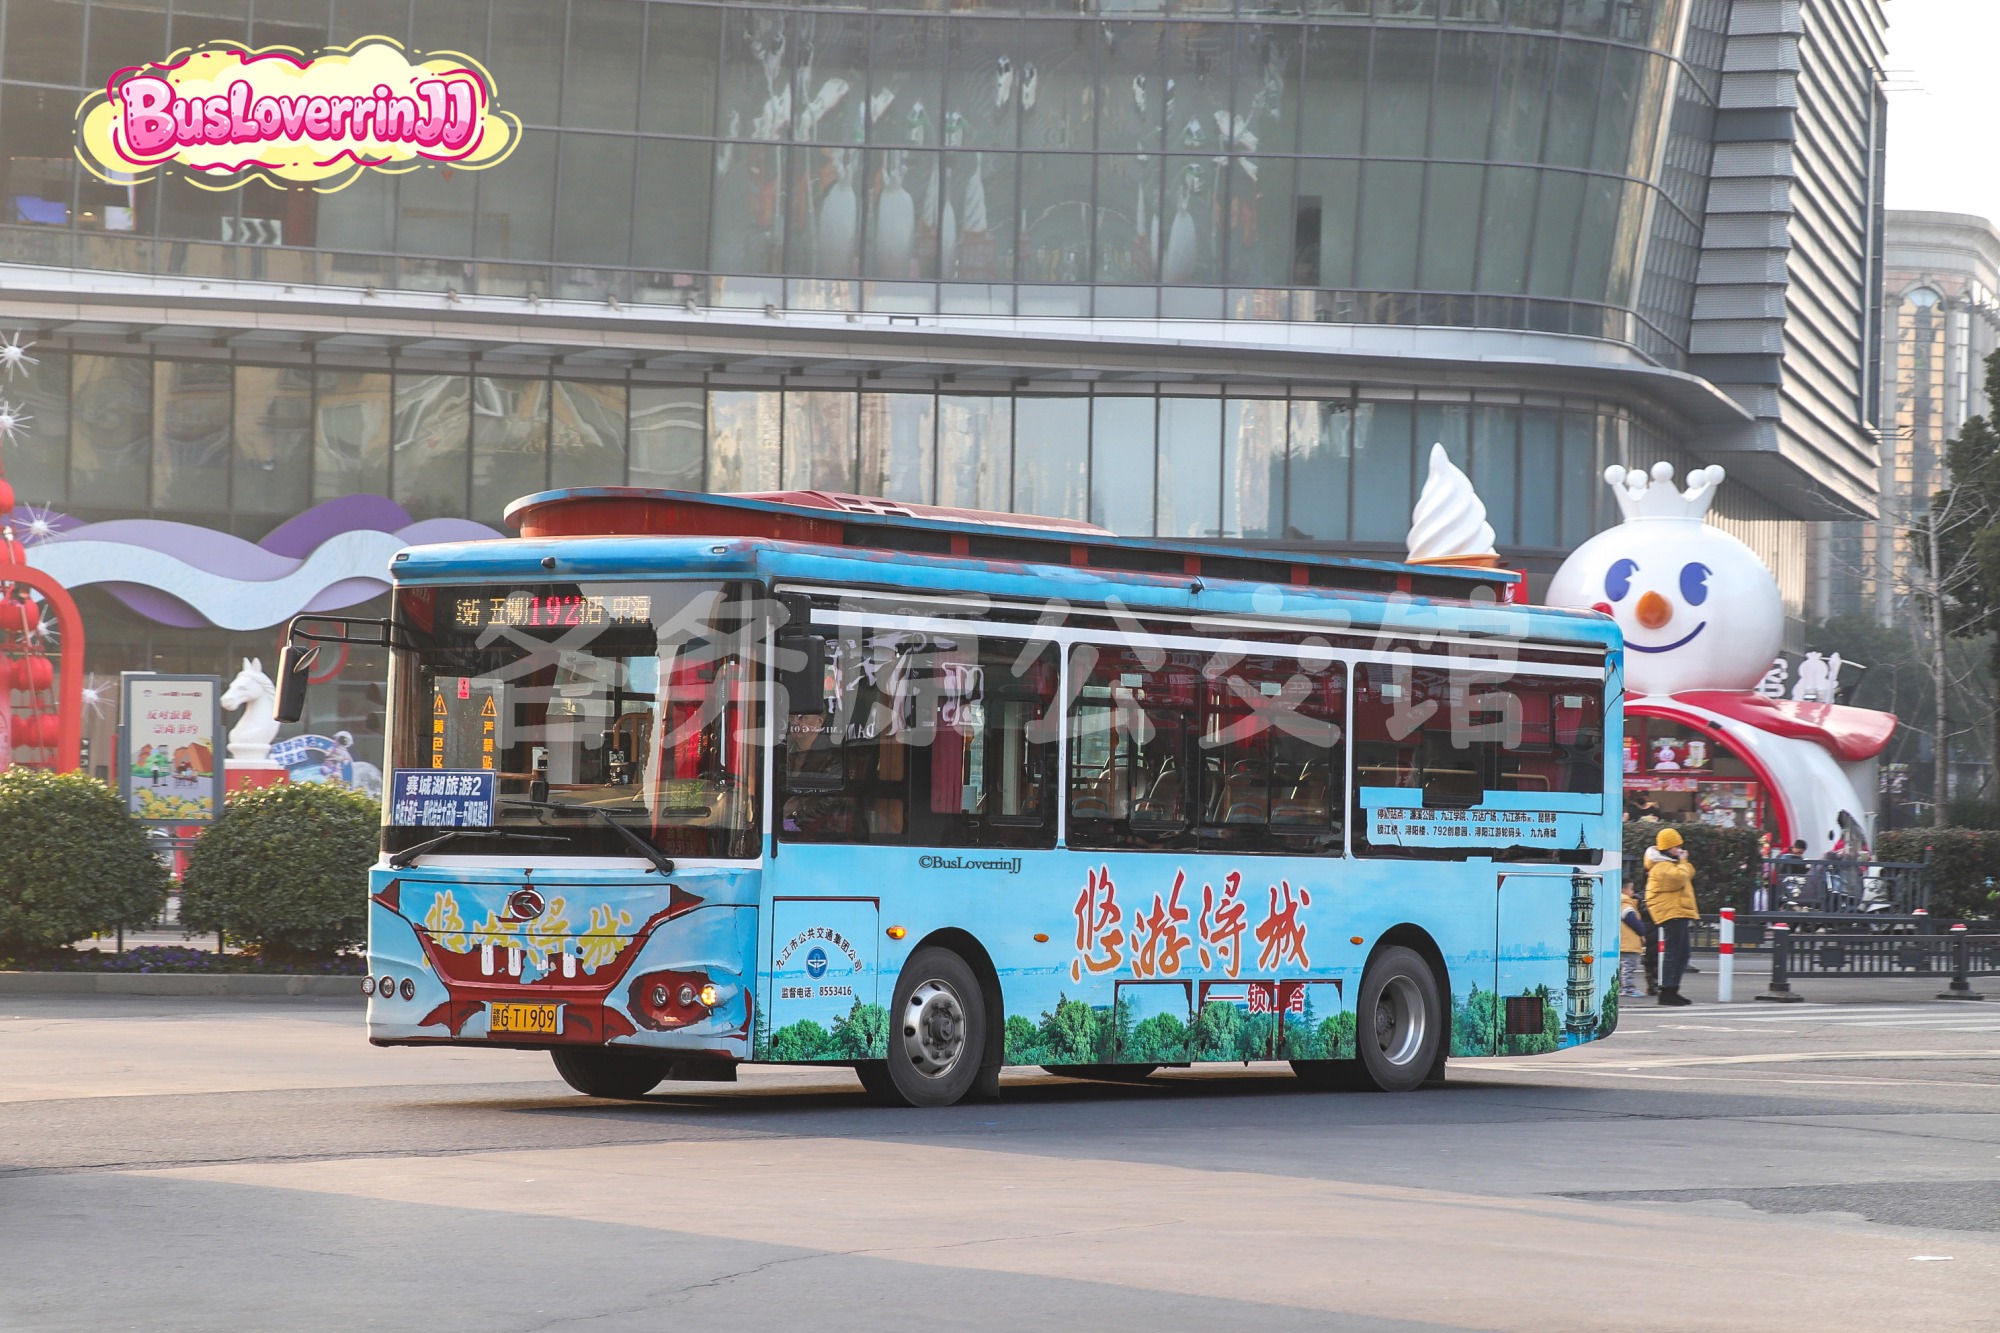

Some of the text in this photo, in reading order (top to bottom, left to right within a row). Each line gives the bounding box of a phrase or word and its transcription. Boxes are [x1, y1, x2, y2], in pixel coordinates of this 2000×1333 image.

[530, 596, 580, 626] 192
[405, 774, 482, 796] 赛城湖旅游2
[1070, 864, 1313, 984] 悠游浔城
[775, 926, 864, 972] 九江市公共交通集团公司
